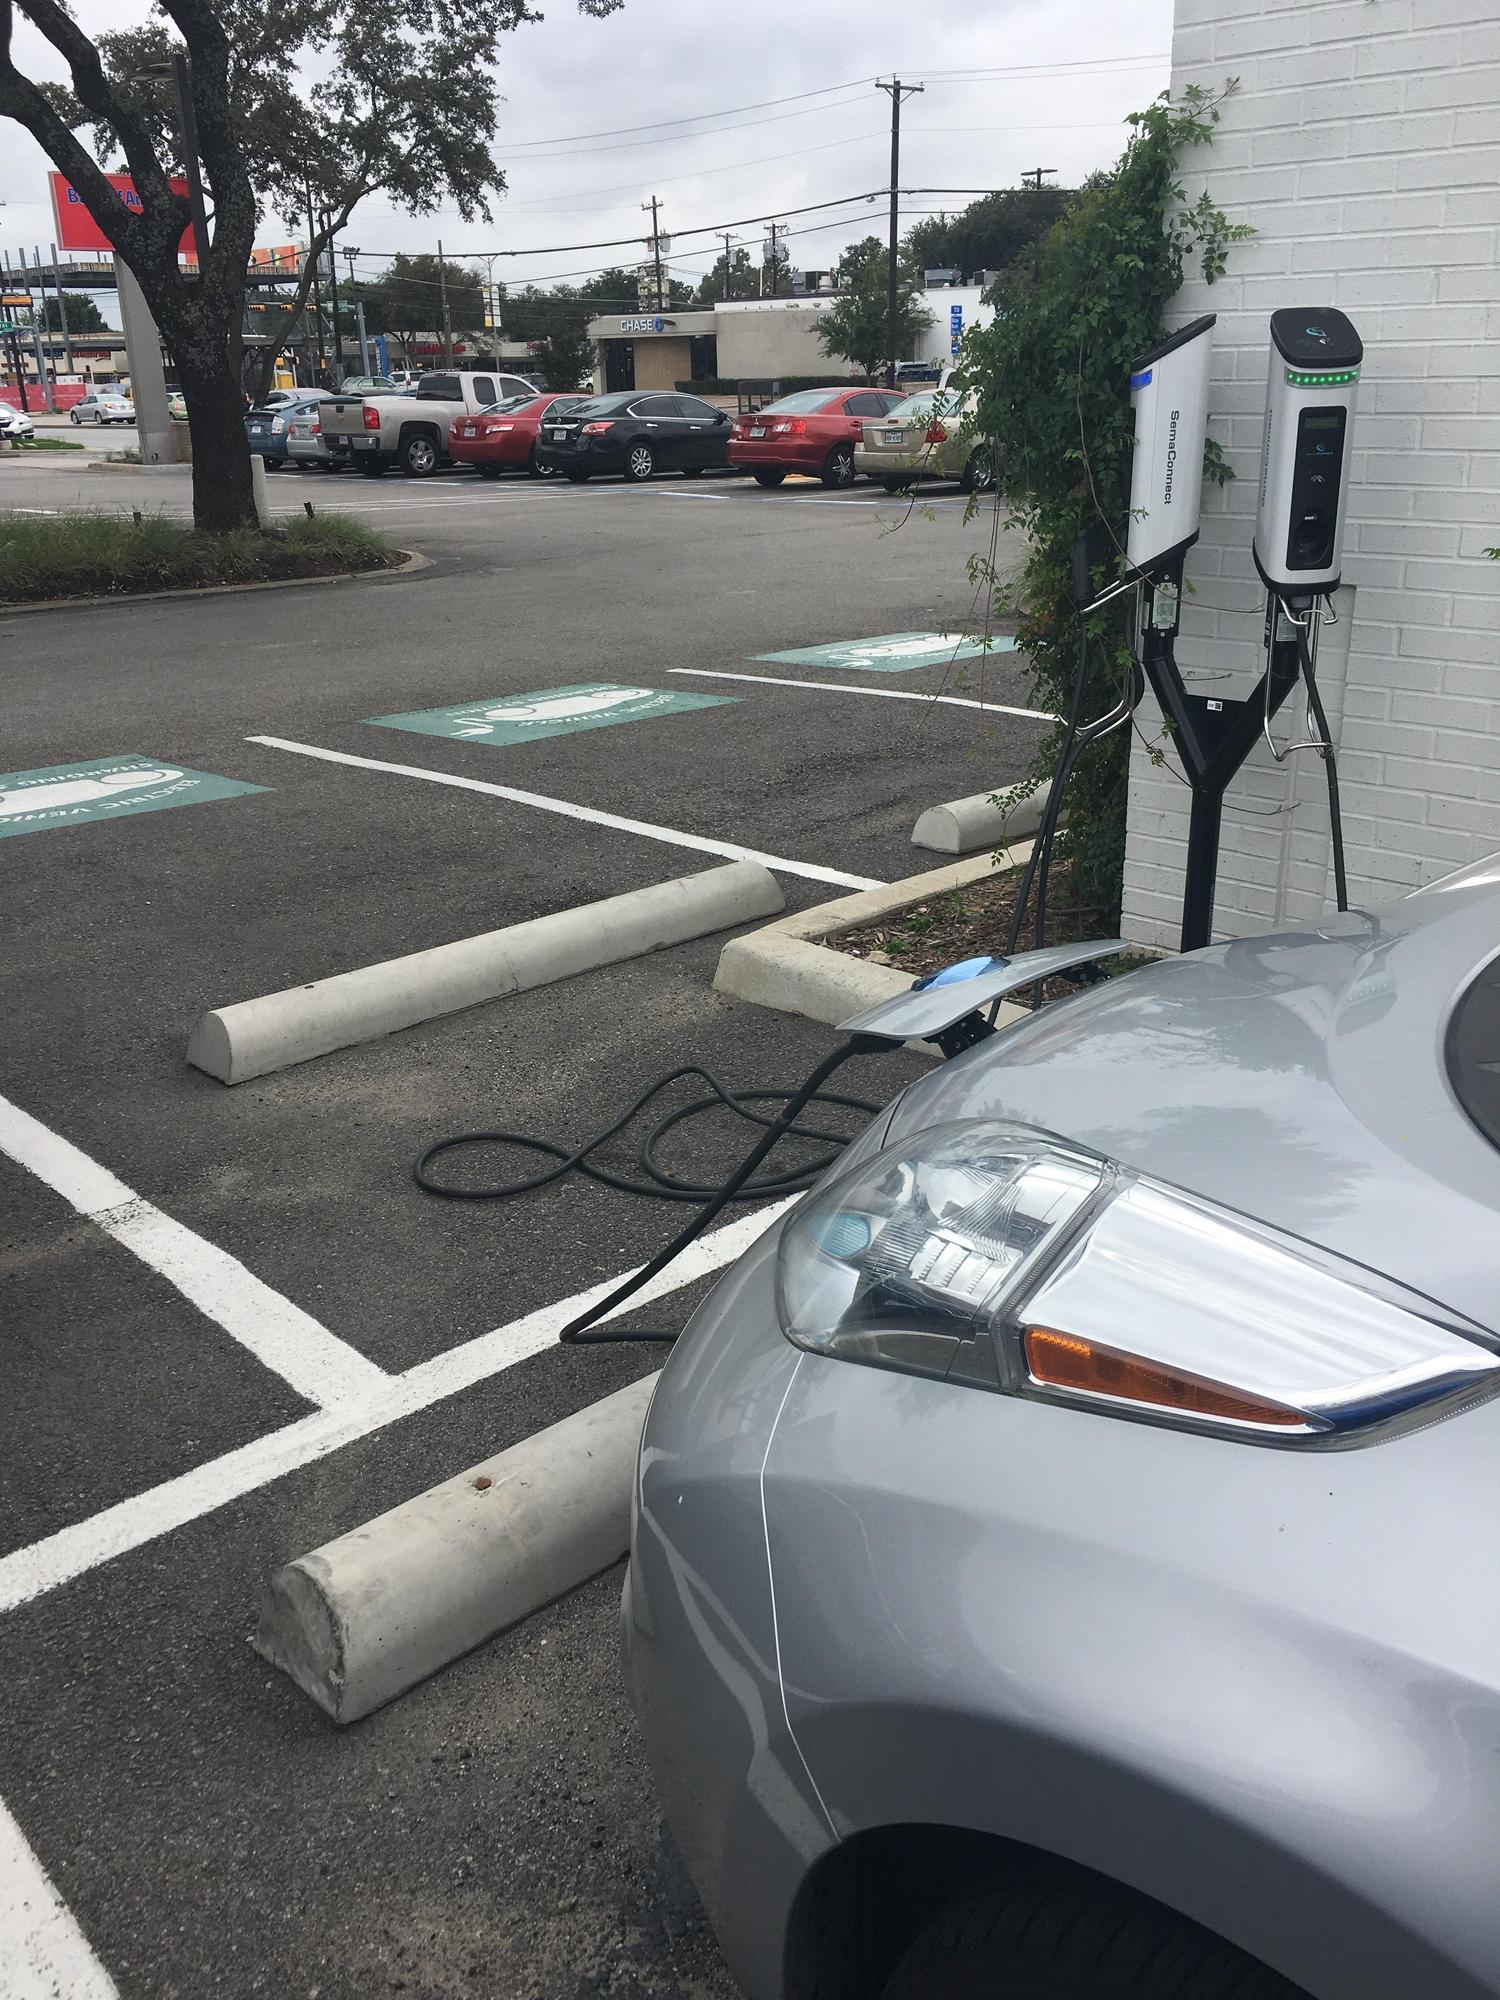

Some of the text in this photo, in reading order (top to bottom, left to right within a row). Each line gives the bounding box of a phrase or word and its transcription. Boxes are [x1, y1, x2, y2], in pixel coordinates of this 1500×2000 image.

[620, 319, 654, 332] CHASE
[1164, 410, 1179, 504] SemaConnect
[17, 763, 154, 787] CHARGING
[98, 779, 201, 809] ELECTRIC
